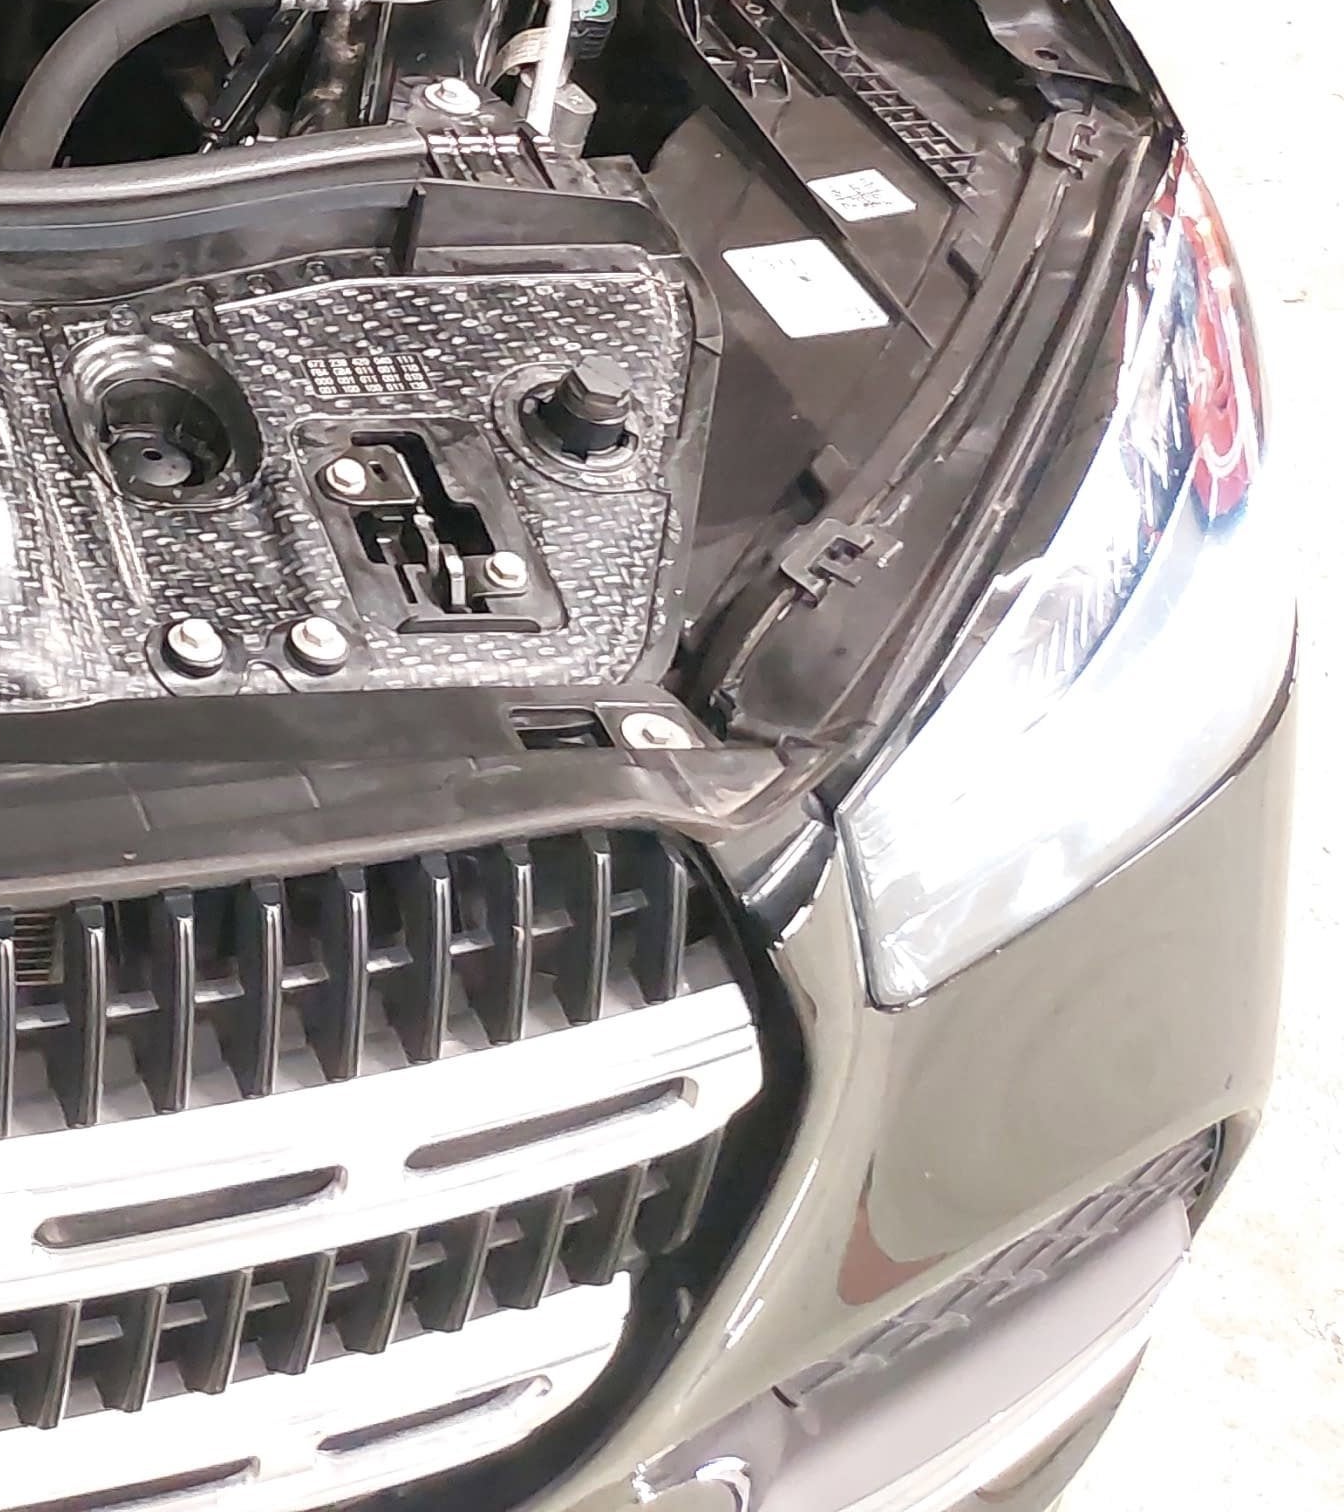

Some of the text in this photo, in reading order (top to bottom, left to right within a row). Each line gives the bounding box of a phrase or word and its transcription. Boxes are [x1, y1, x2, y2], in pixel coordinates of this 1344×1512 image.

[354, 367, 374, 375] 011
[314, 377, 334, 386] 000
[318, 386, 337, 394] 001
[386, 383, 405, 391] 011
